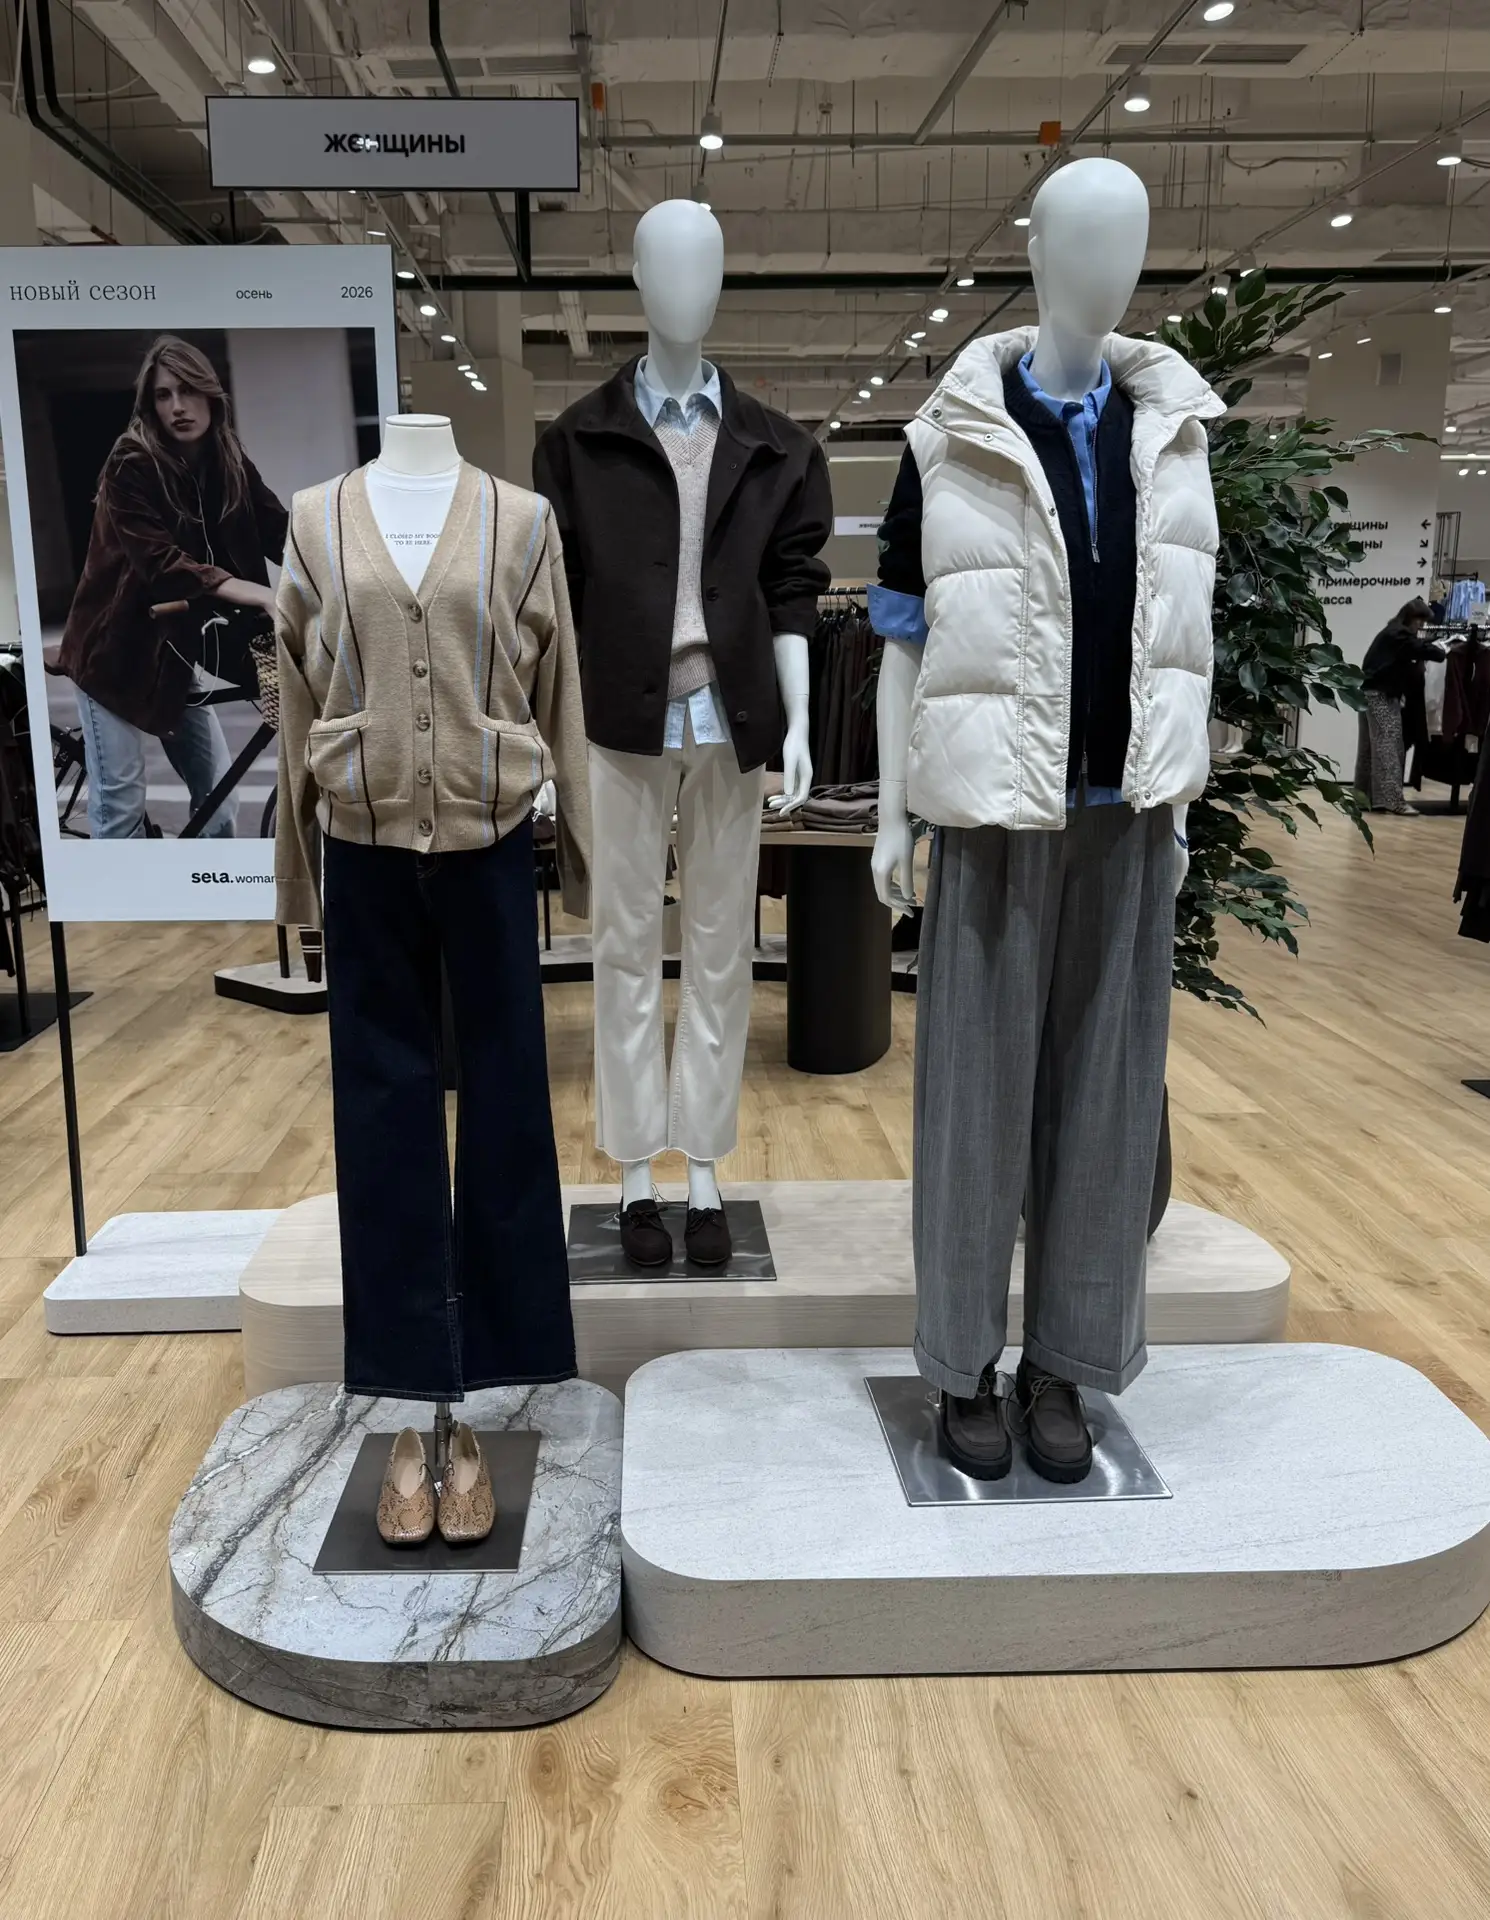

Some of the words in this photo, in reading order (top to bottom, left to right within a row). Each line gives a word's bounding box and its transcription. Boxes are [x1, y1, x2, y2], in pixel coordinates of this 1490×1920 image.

[324, 133, 466, 157] женщины
[9, 279, 80, 301] новый
[89, 284, 157, 301] сезон
[235, 289, 273, 299] осень
[340, 286, 374, 299] 2026
[1317, 577, 1411, 588] примерочные
